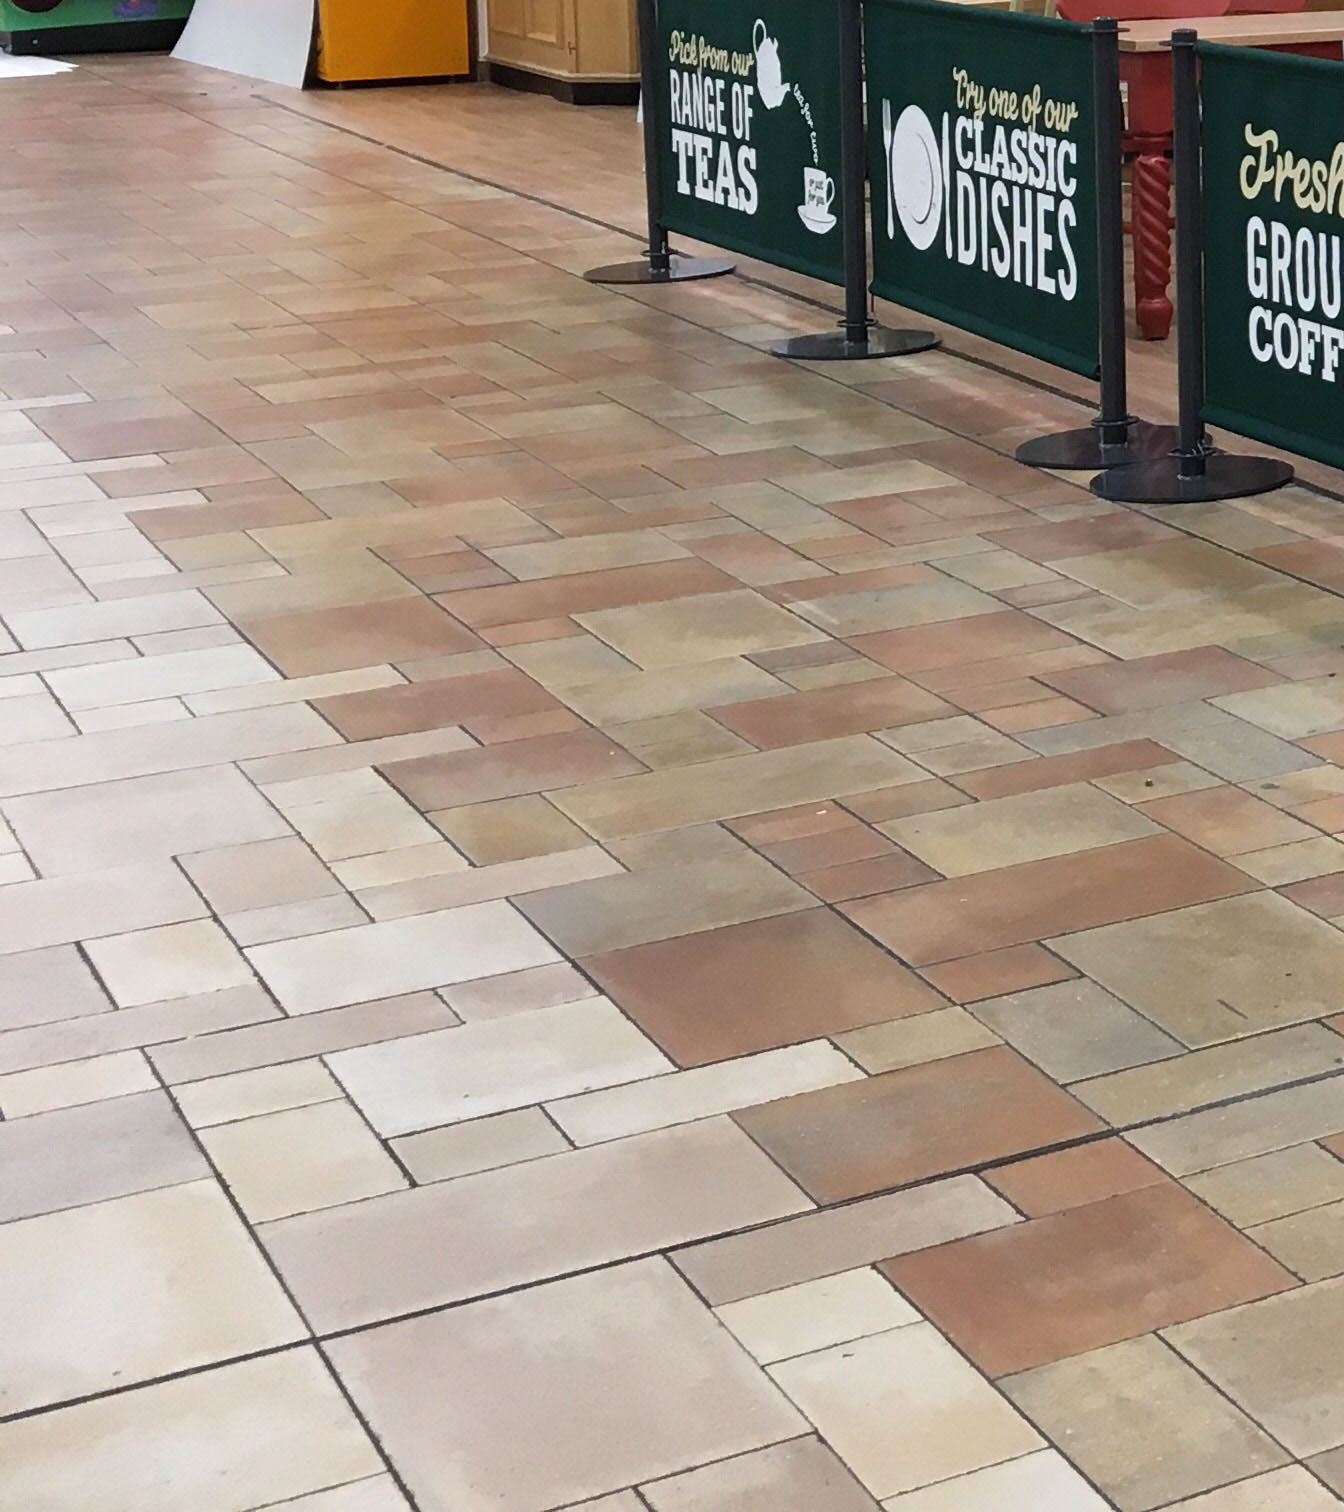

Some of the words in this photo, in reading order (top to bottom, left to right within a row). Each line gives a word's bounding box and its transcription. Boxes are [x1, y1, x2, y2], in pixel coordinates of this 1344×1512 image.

[669, 30, 698, 66] Pick
[697, 36, 730, 74] from
[731, 51, 755, 76] our
[669, 68, 727, 135] RANGE
[731, 81, 754, 141] OF
[952, 66, 986, 121] Try
[988, 87, 1019, 121] one
[1021, 83, 1042, 134] of
[1044, 98, 1078, 132] our
[671, 128, 758, 215] TEAS
[955, 115, 1077, 198] CLASSIC
[956, 169, 1077, 301] DISHES
